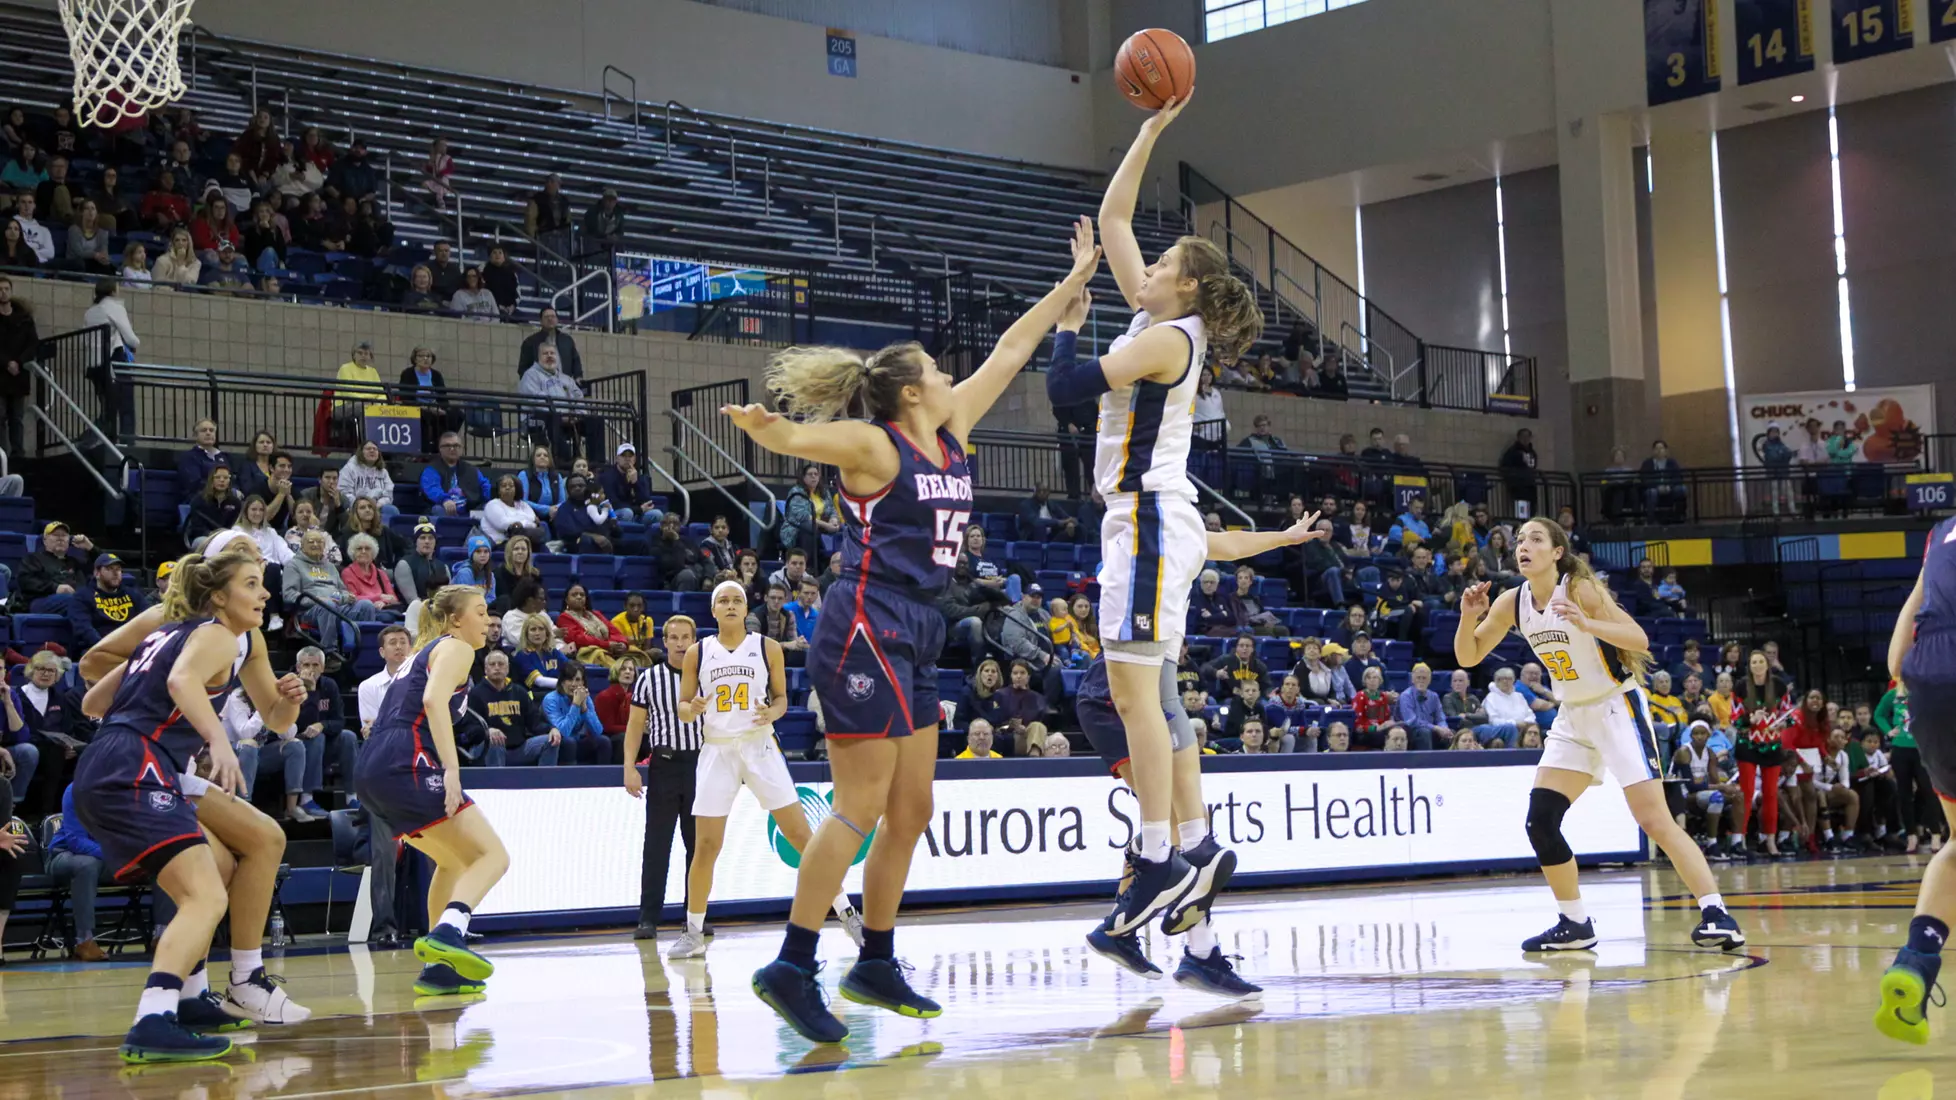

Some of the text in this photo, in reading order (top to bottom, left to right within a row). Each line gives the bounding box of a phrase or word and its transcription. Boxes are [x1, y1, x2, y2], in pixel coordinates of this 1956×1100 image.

[1842, 5, 1884, 47] 15
[831, 38, 852, 55] 205
[1747, 28, 1787, 68] 14
[833, 57, 850, 74] GA
[1666, 52, 1686, 87] 3
[1751, 404, 1804, 419] CHUCK
[377, 423, 412, 445] 103
[1915, 486, 1947, 504] 106
[932, 509, 971, 568] 55
[1134, 613, 1152, 631] MU
[1528, 629, 1571, 649] MARQUETTE
[710, 664, 756, 683] MARQUETTE
[1538, 649, 1580, 682] 52
[715, 682, 750, 713] 24
[1107, 785, 1265, 850] Srts
